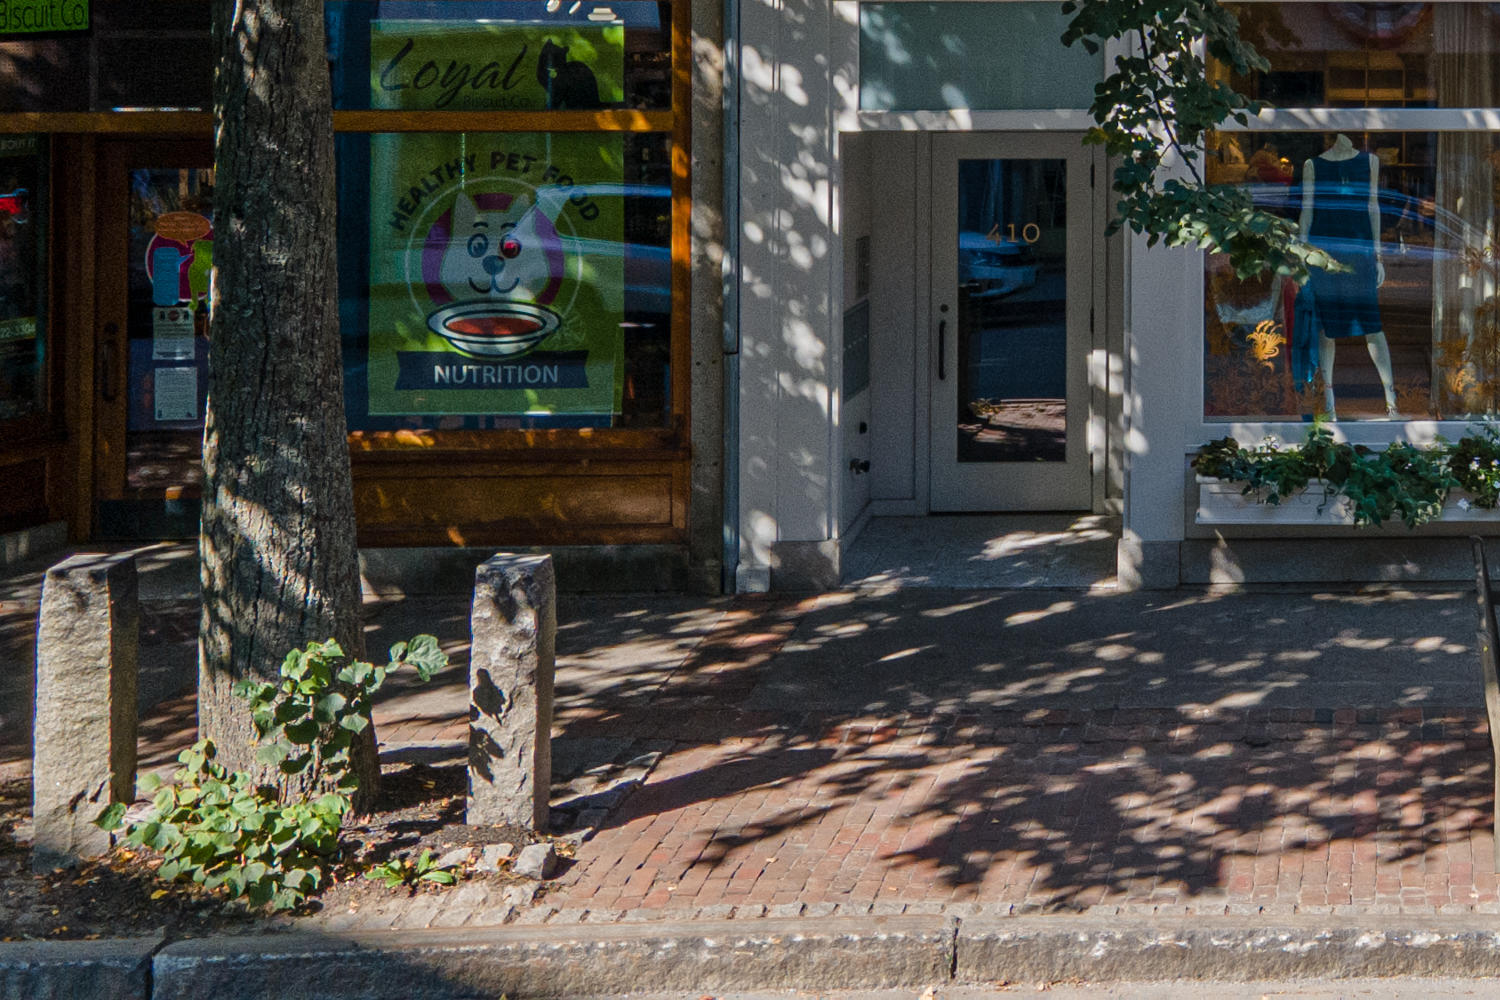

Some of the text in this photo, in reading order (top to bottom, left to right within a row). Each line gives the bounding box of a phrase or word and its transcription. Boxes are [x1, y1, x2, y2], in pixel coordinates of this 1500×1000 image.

[381, 38, 528, 108] Loyal
[388, 151, 600, 231] HEALTHY PET FOOD
[985, 222, 1041, 246] 410
[434, 364, 559, 384] NUTRITION
